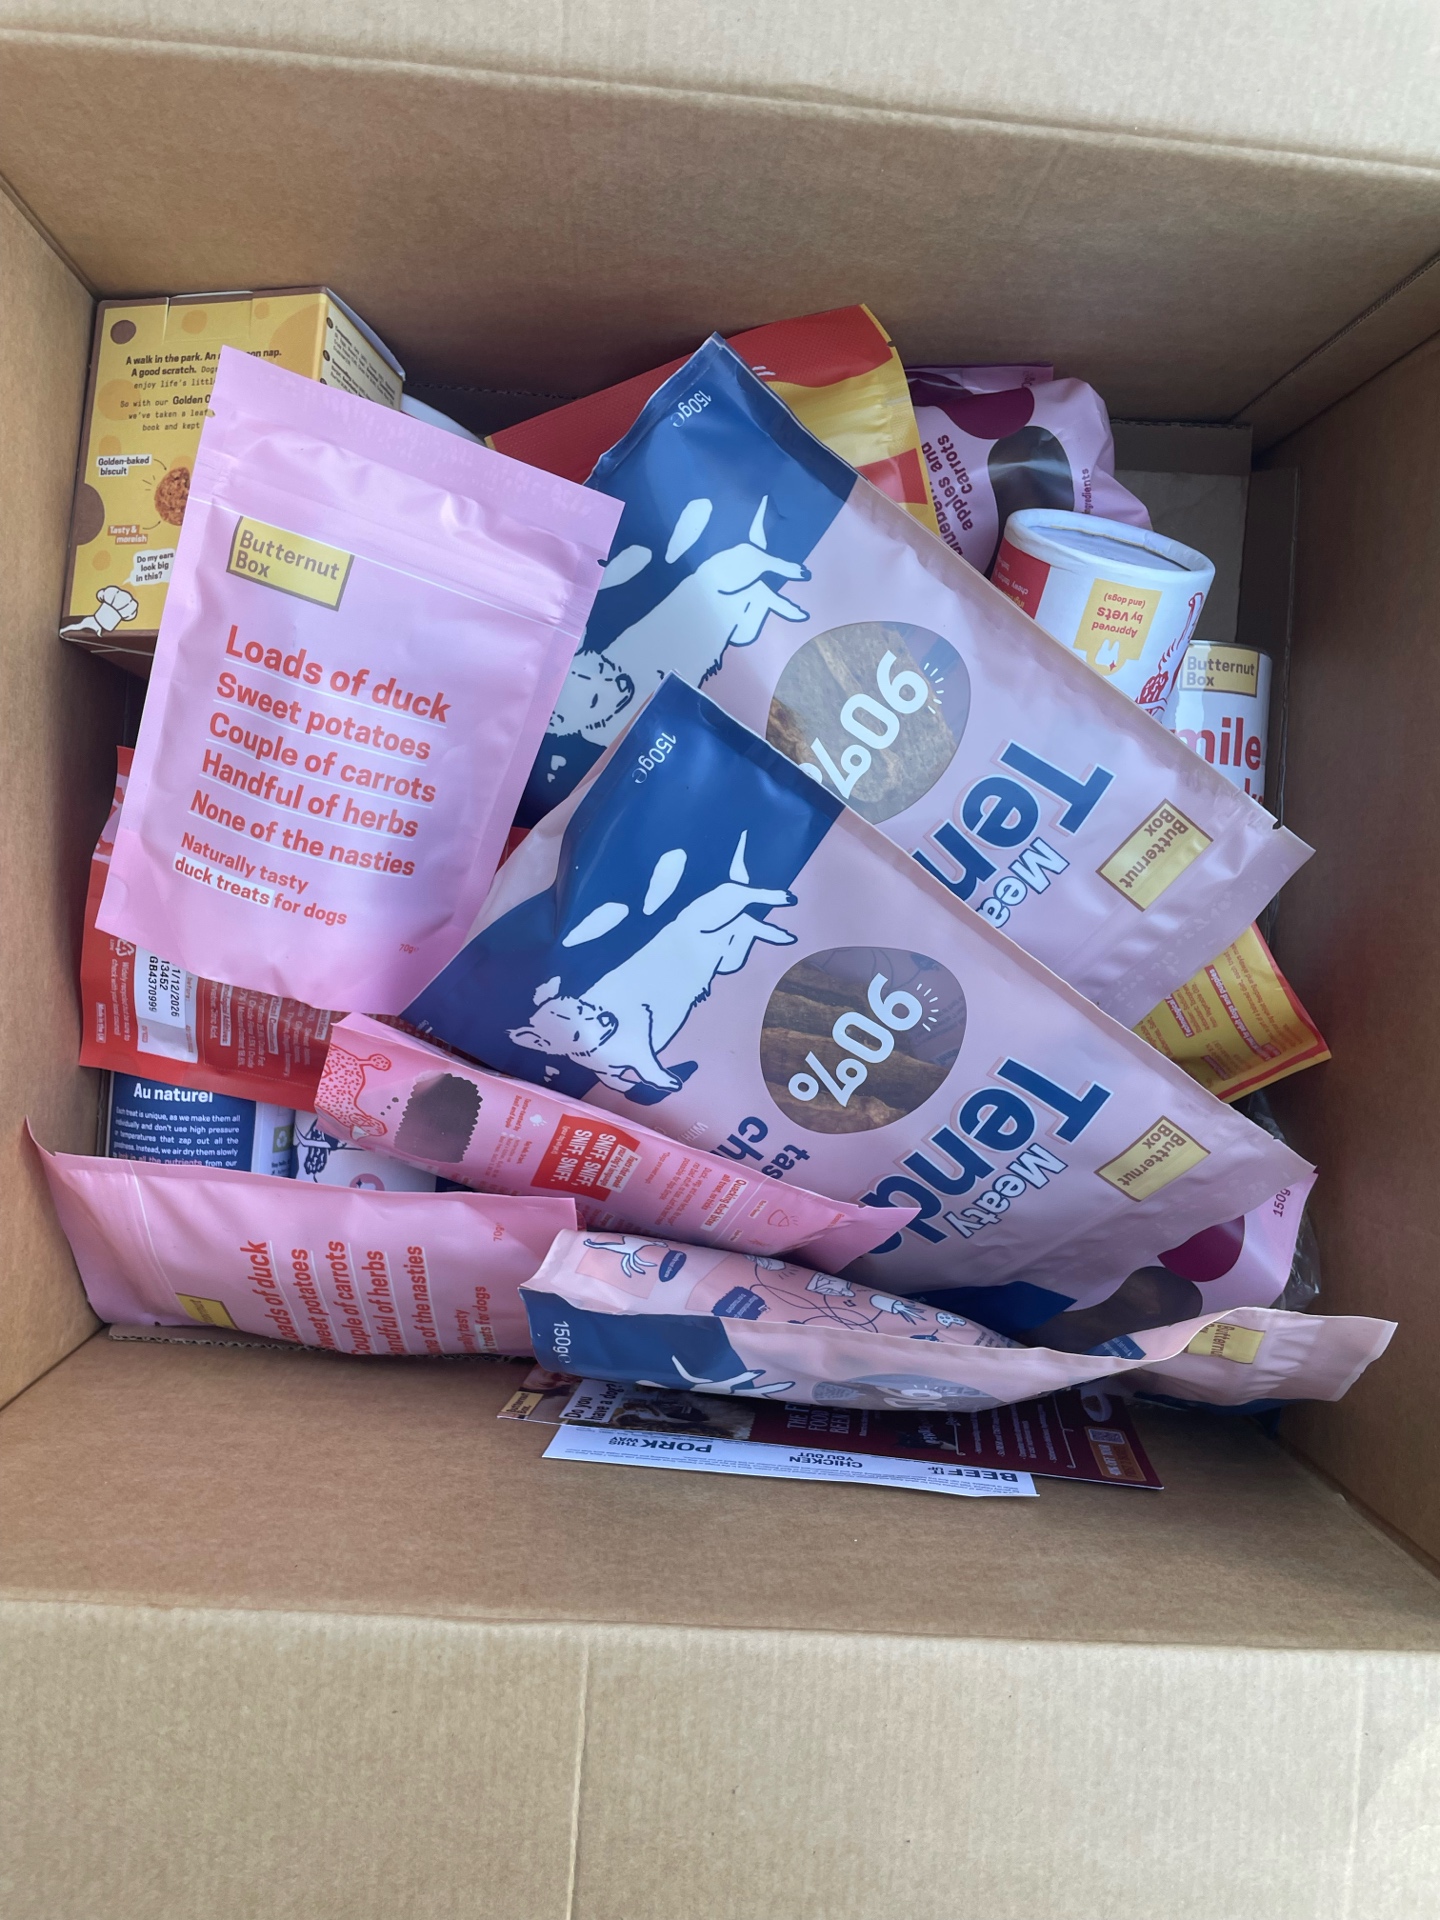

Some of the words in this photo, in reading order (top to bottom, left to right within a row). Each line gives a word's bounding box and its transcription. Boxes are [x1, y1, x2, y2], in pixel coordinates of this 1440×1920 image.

[126, 356, 132, 365] A
[133, 355, 153, 365] walk
[155, 355, 163, 364] in
[165, 353, 179, 363] the
[181, 353, 203, 364] park.
[205, 351, 216, 361] An
[263, 350, 282, 359] nap.
[131, 368, 138, 377] A
[139, 367, 161, 378] good
[162, 365, 197, 375] scratch.
[134, 381, 157, 390] enjoy
[160, 380, 187, 388] life's
[120, 400, 129, 408] So
[133, 400, 151, 408] with
[155, 399, 169, 407] our
[172, 395, 203, 405] Golden
[129, 412, 151, 420] we've
[155, 410, 177, 419] taken
[190, 408, 209, 417] leaf
[142, 423, 160, 431] book
[165, 422, 178, 431] and
[182, 422, 200, 431] kept
[98, 456, 150, 467] Golden-baked
[937, 434, 973, 495] carrots
[100, 468, 127, 476] biscuit
[938, 476, 974, 531] apples
[109, 526, 131, 535] Tasty
[131, 525, 137, 533] &
[116, 535, 147, 544] moreish
[136, 555, 147, 564] Do
[147, 554, 158, 563] my
[159, 552, 174, 560] ears
[235, 549, 269, 578] Box
[239, 529, 340, 580] Butternut
[141, 562, 156, 572] look
[158, 561, 169, 571] big
[144, 571, 163, 581] this?
[1103, 592, 1125, 607] dogs)
[1123, 596, 1147, 609] (and
[1097, 605, 1130, 623] vets
[1130, 610, 1144, 624] by
[1091, 620, 1139, 639] Approved
[225, 624, 322, 687] Loads
[329, 669, 370, 698] of
[371, 677, 451, 724] duck
[1187, 655, 1255, 677] Butternut
[1186, 671, 1215, 687] Box
[216, 671, 303, 725] Sweet
[304, 706, 431, 761] potatoes
[209, 712, 298, 768] Couple
[304, 750, 336, 777] of
[340, 762, 436, 804] carrots
[201, 748, 303, 810] Handful
[307, 791, 338, 819] of
[343, 797, 419, 839] herbs
[1144, 808, 1176, 837] Box
[190, 789, 246, 832] None
[250, 820, 279, 844] of
[281, 827, 324, 857] the
[328, 837, 415, 877] nasties
[181, 831, 256, 879] Naturally
[259, 866, 309, 894] tasty
[1119, 819, 1189, 889] Butternut
[174, 856, 212, 886] duck
[216, 875, 270, 905] treats
[273, 894, 301, 914] for
[303, 904, 347, 926] dogs
[159, 960, 170, 991] 13452
[1207, 966, 1228, 995] puppies
[170, 965, 181, 1018] 1/12/2026
[1219, 992, 1231, 1006] and
[1226, 1003, 1241, 1020] dogs
[788, 974, 924, 1108] 90%
[134, 1083, 151, 1099] Au
[154, 1087, 213, 1103] naturel
[145, 1112, 169, 1122] unique,
[169, 1114, 178, 1122] as
[191, 1114, 211, 1123] make
[212, 1114, 231, 1123] them
[232, 1114, 241, 1123] all
[141, 1121, 153, 1131] and
[154, 1122, 172, 1132] don't
[174, 1125, 188, 1133] use
[189, 1124, 206, 1135] high
[208, 1126, 240, 1135] pressure
[1142, 1124, 1174, 1149] Box
[160, 1136, 175, 1144] that
[178, 1137, 192, 1146] zap
[196, 1136, 210, 1145] out
[214, 1136, 223, 1145] all
[226, 1136, 239, 1145] the
[561, 1129, 593, 1157] SNIFF,
[585, 1133, 617, 1161] SNIFF,
[171, 1147, 182, 1155] air
[183, 1148, 195, 1158] dry
[195, 1148, 215, 1156] them
[216, 1148, 239, 1157] slowly
[1117, 1133, 1187, 1186] Butternut
[205, 1159, 223, 1167] from
[550, 1156, 579, 1182] SNIFF.
[570, 1160, 602, 1187] SNIFF,
[719, 1179, 747, 1204] Quacking
[946, 1142, 1068, 1240] Meaty
[713, 1203, 729, 1215] duck
[704, 1214, 721, 1227] bites
[240, 1239, 277, 1289] duck
[325, 1241, 355, 1300] carrots
[361, 1250, 391, 1297] herbs
[403, 1246, 430, 1301] nasties
[291, 1248, 330, 1316] potatoes
[252, 1288, 285, 1307] of
[368, 1298, 394, 1314] of
[472, 1286, 491, 1313] dogs
[332, 1301, 360, 1316] of
[411, 1303, 433, 1324] the
[264, 1308, 303, 1345] oads
[454, 1309, 471, 1332] tasty
[474, 1312, 491, 1325] for
[372, 1315, 407, 1355] andful
[413, 1325, 437, 1338] of
[479, 1326, 497, 1347] treats
[564, 1405, 585, 1419] Do
[575, 1396, 593, 1410] you
[585, 1405, 610, 1422] have
[642, 1438, 713, 1454] PORK
[798, 1451, 825, 1460] OUT
[788, 1455, 863, 1469] CHICKEN
[828, 1453, 854, 1462] YOU
[947, 1468, 1019, 1483] BEEF
